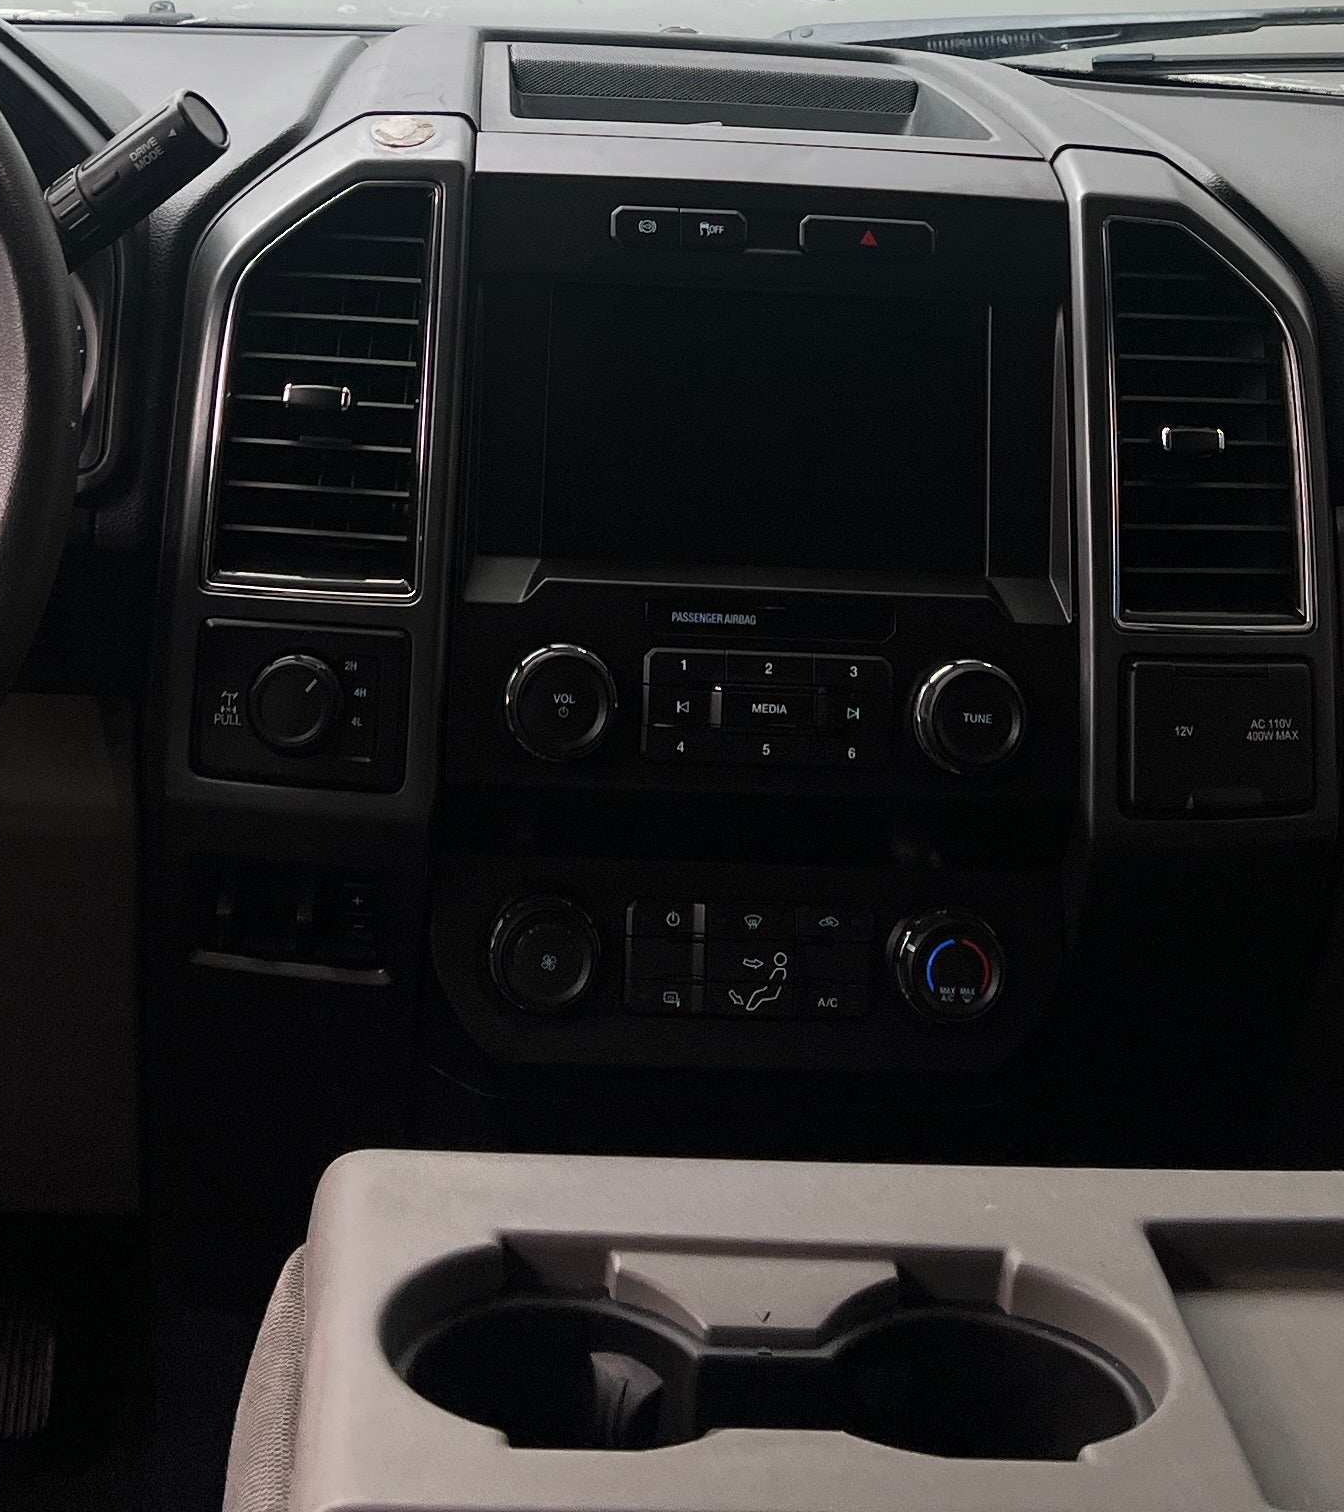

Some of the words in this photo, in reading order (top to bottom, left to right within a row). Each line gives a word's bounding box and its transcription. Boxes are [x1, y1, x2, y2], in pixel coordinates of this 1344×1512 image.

[129, 135, 159, 162] DRIVE
[133, 145, 166, 172] MODE
[709, 224, 726, 235] OFF
[671, 611, 724, 625] PASSENGER
[724, 613, 758, 626] AIRBAG
[344, 660, 358, 672] 2H
[680, 659, 688, 672] 1
[764, 662, 774, 675] 2
[849, 665, 859, 678] 3
[553, 693, 576, 706] VOL
[751, 702, 788, 716] MEDIA
[213, 712, 242, 728] PULL
[962, 712, 993, 725] TUNE
[1250, 718, 1266, 730] AC
[1267, 718, 1293, 729] 110V
[1174, 725, 1194, 737] 12V
[1246, 731, 1274, 742] 400W
[1275, 730, 1300, 741] MAX
[676, 740, 685, 754] 4
[762, 743, 771, 757] 5
[847, 746, 857, 760] 6
[816, 997, 839, 1009] A/C
